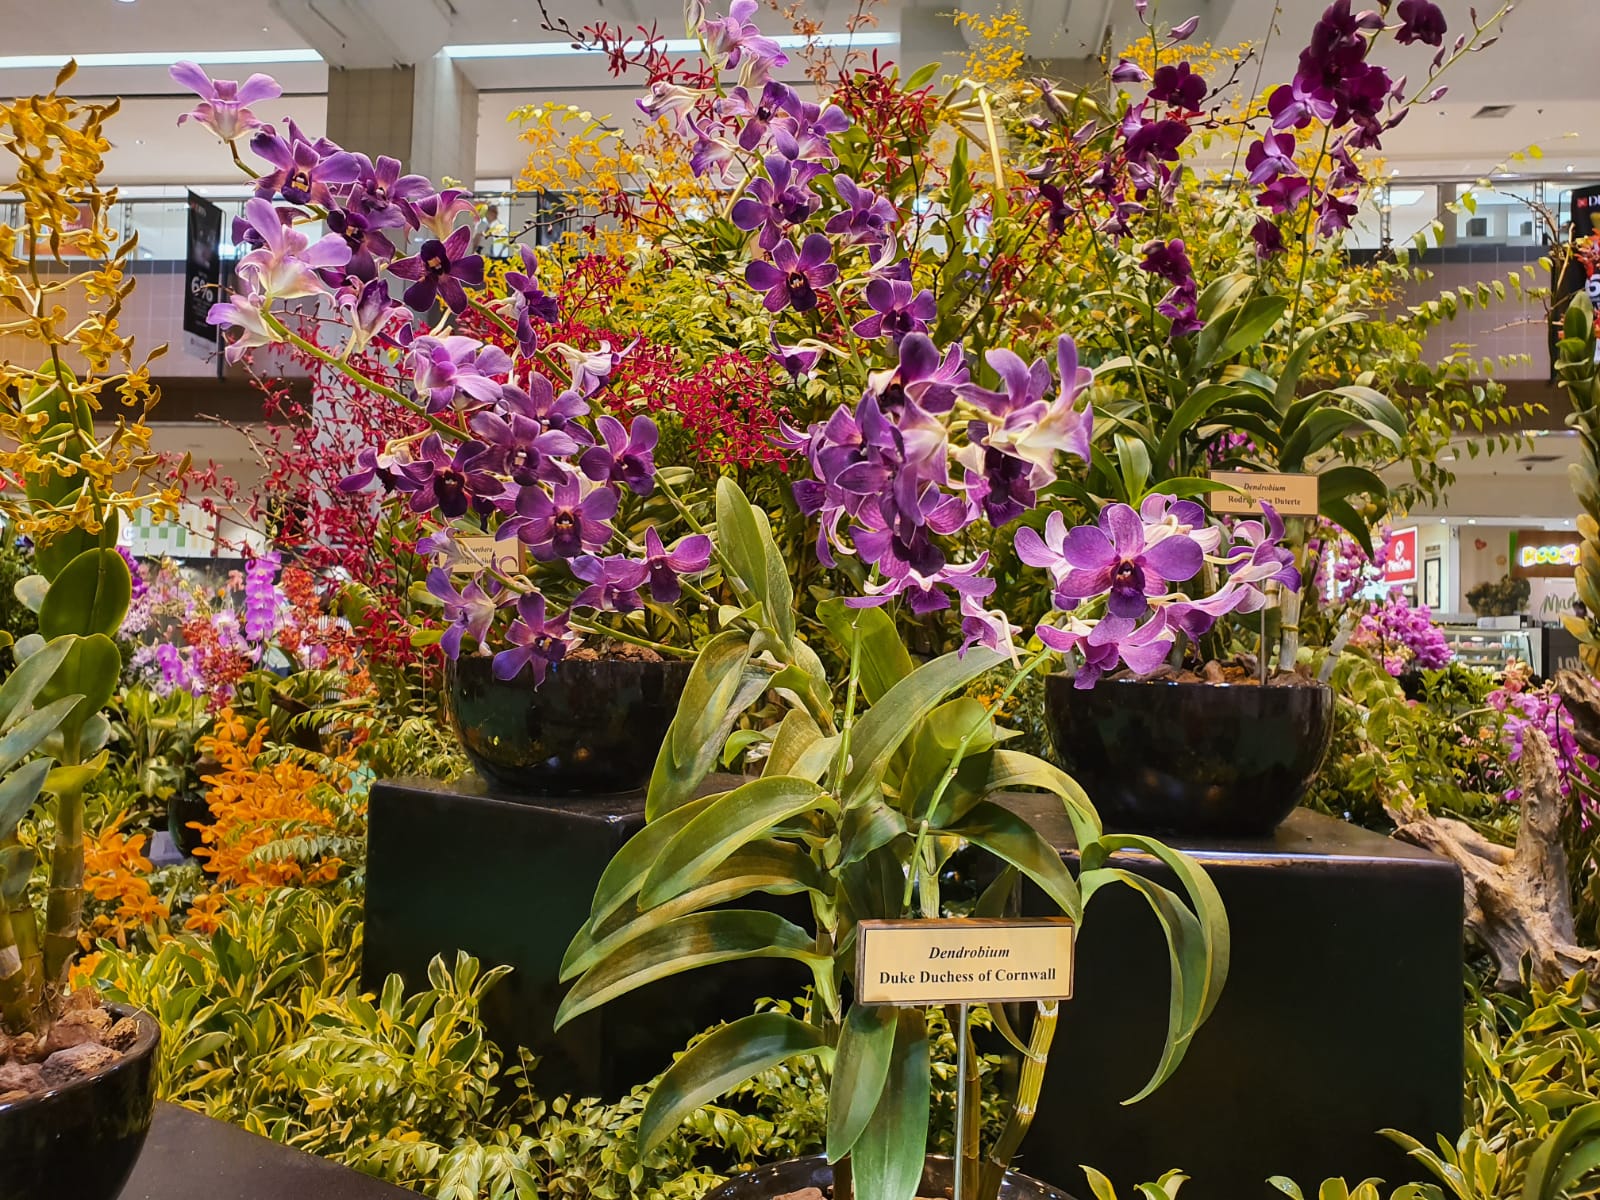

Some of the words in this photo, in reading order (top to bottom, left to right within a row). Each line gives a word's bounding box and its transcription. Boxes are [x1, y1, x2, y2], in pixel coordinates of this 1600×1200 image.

[1243, 483, 1286, 492] Dendrobium
[928, 946, 1010, 960] Dendrobium
[879, 971, 916, 985] Duke
[920, 969, 974, 984] Duchess
[978, 969, 992, 982] of
[995, 968, 1056, 982] Cornwall
